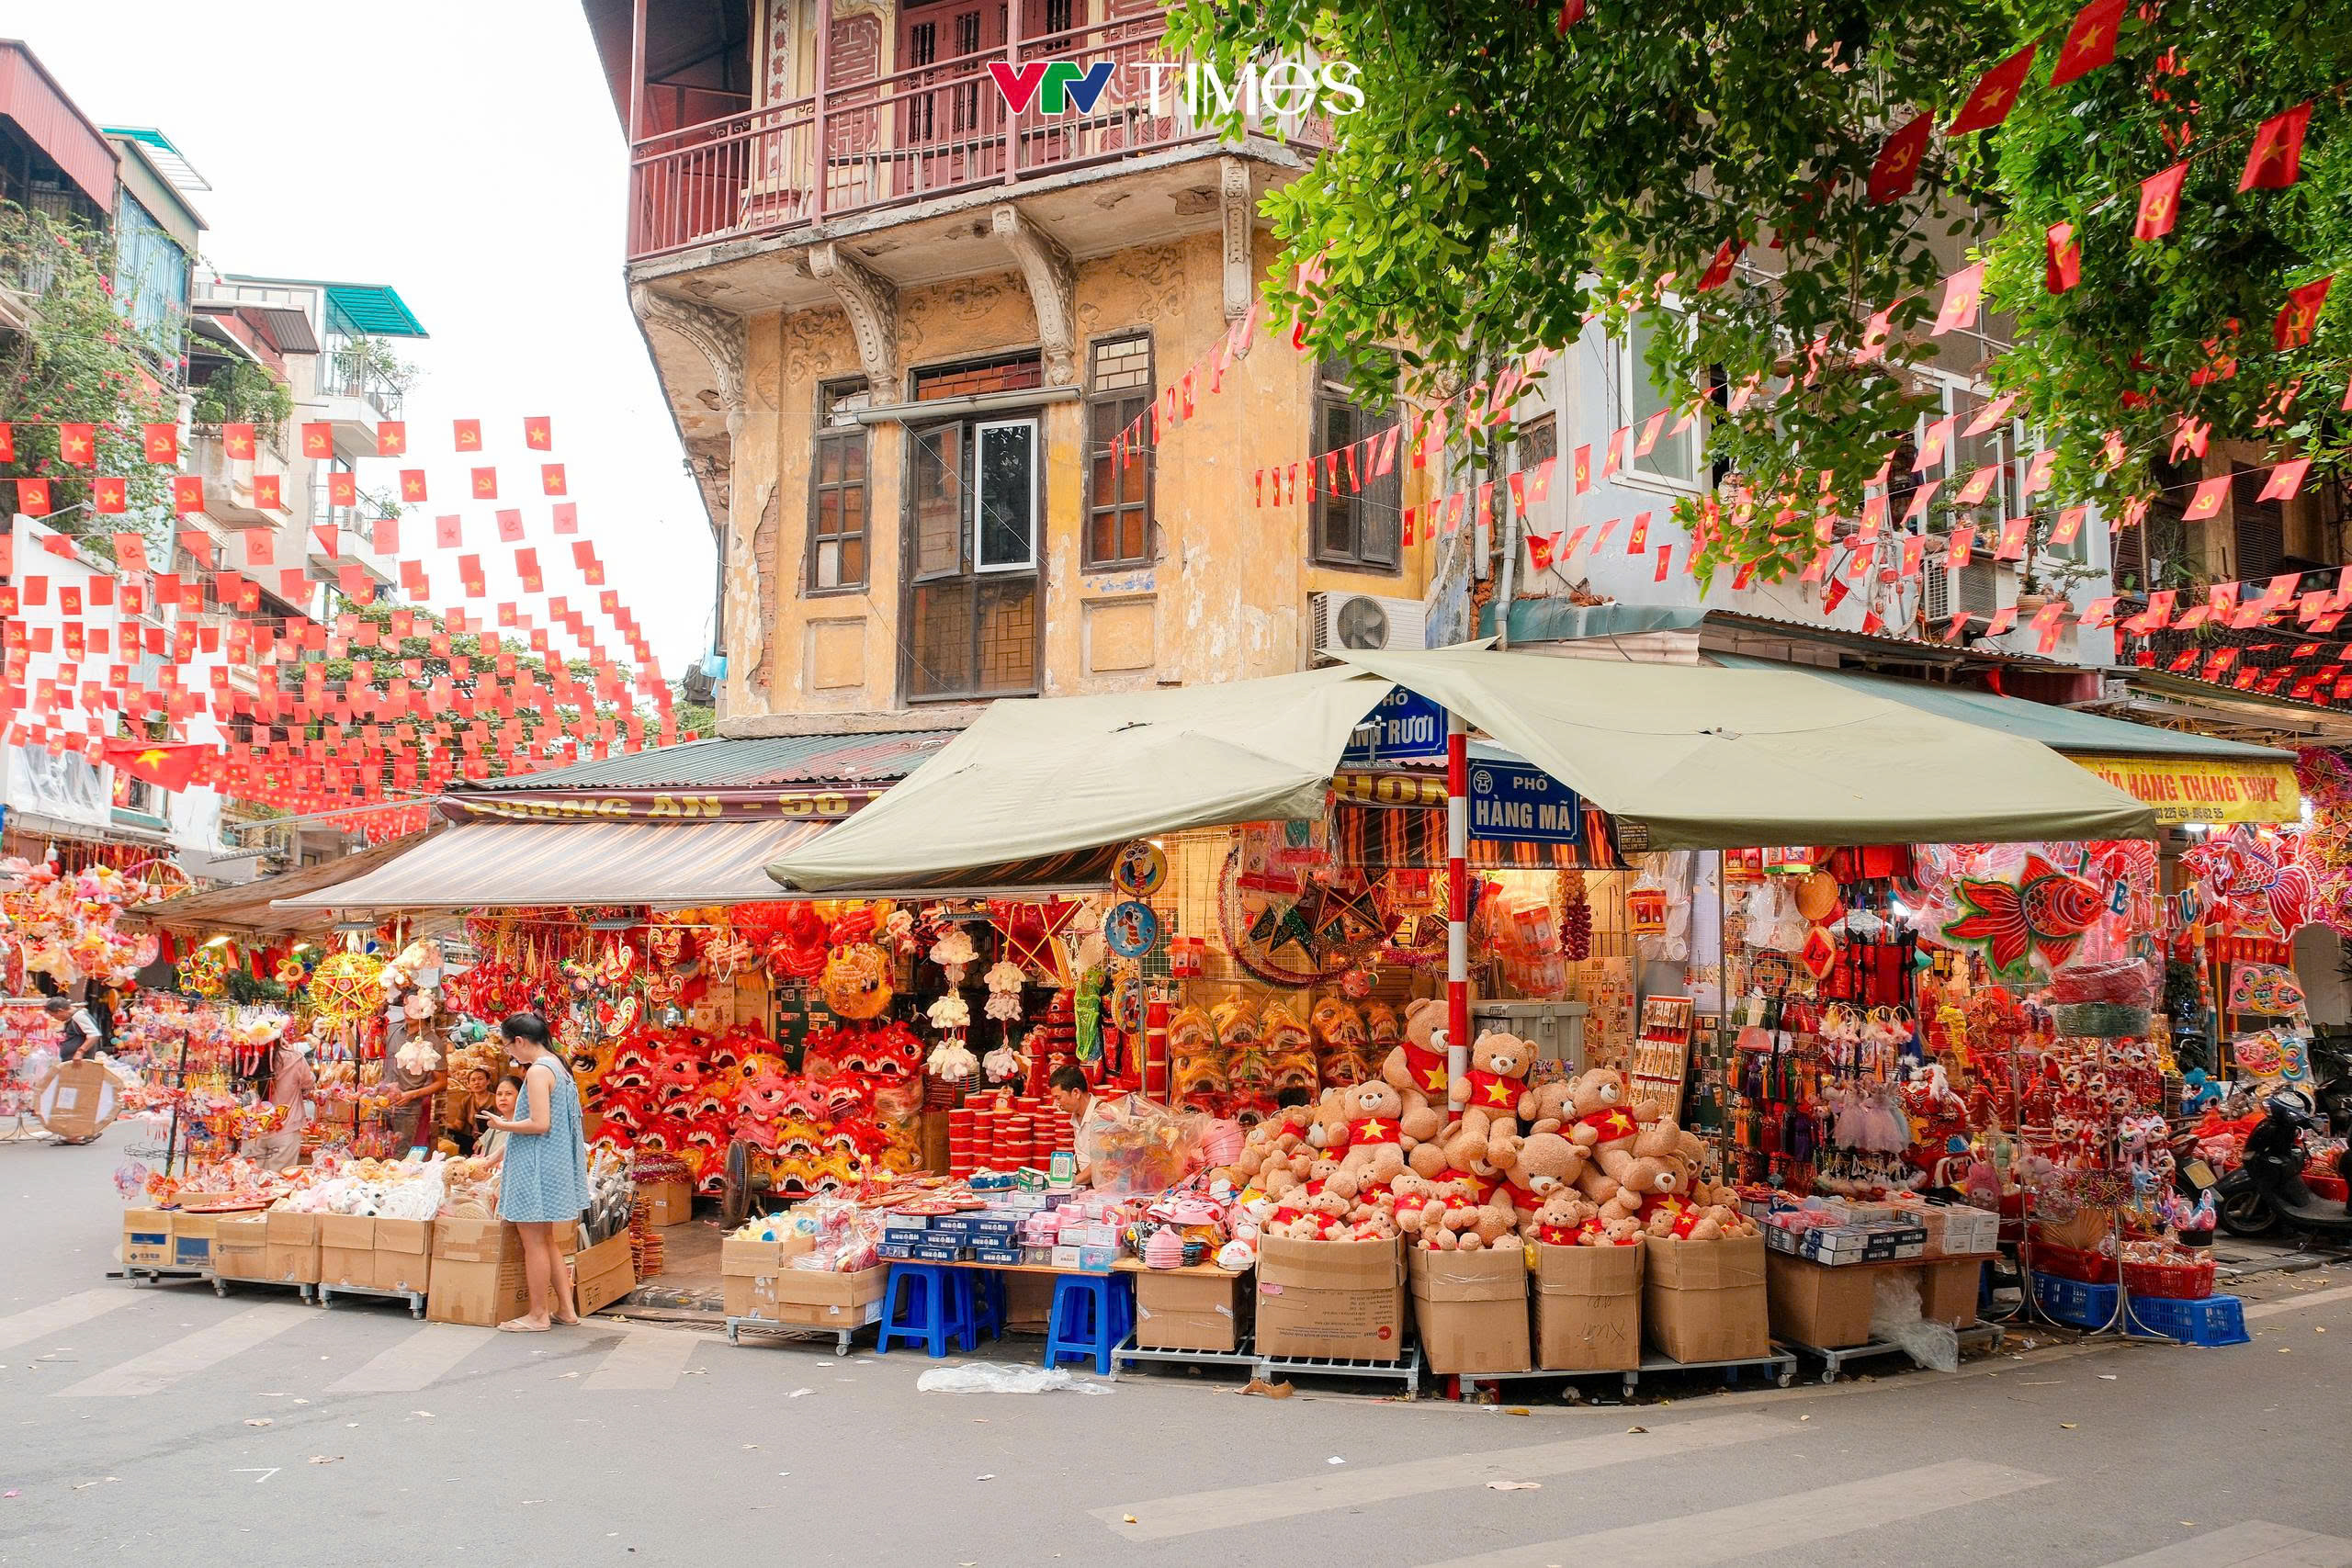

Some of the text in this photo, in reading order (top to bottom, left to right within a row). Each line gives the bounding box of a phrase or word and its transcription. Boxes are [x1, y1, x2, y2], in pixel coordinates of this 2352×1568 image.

[1388, 715, 1434, 745] RƯƠI
[1512, 773, 1548, 792] PHỐ
[2127, 767, 2179, 802] HÀNG
[779, 792, 849, 816] 56
[1476, 794, 1571, 831] HÀNG MÃ
